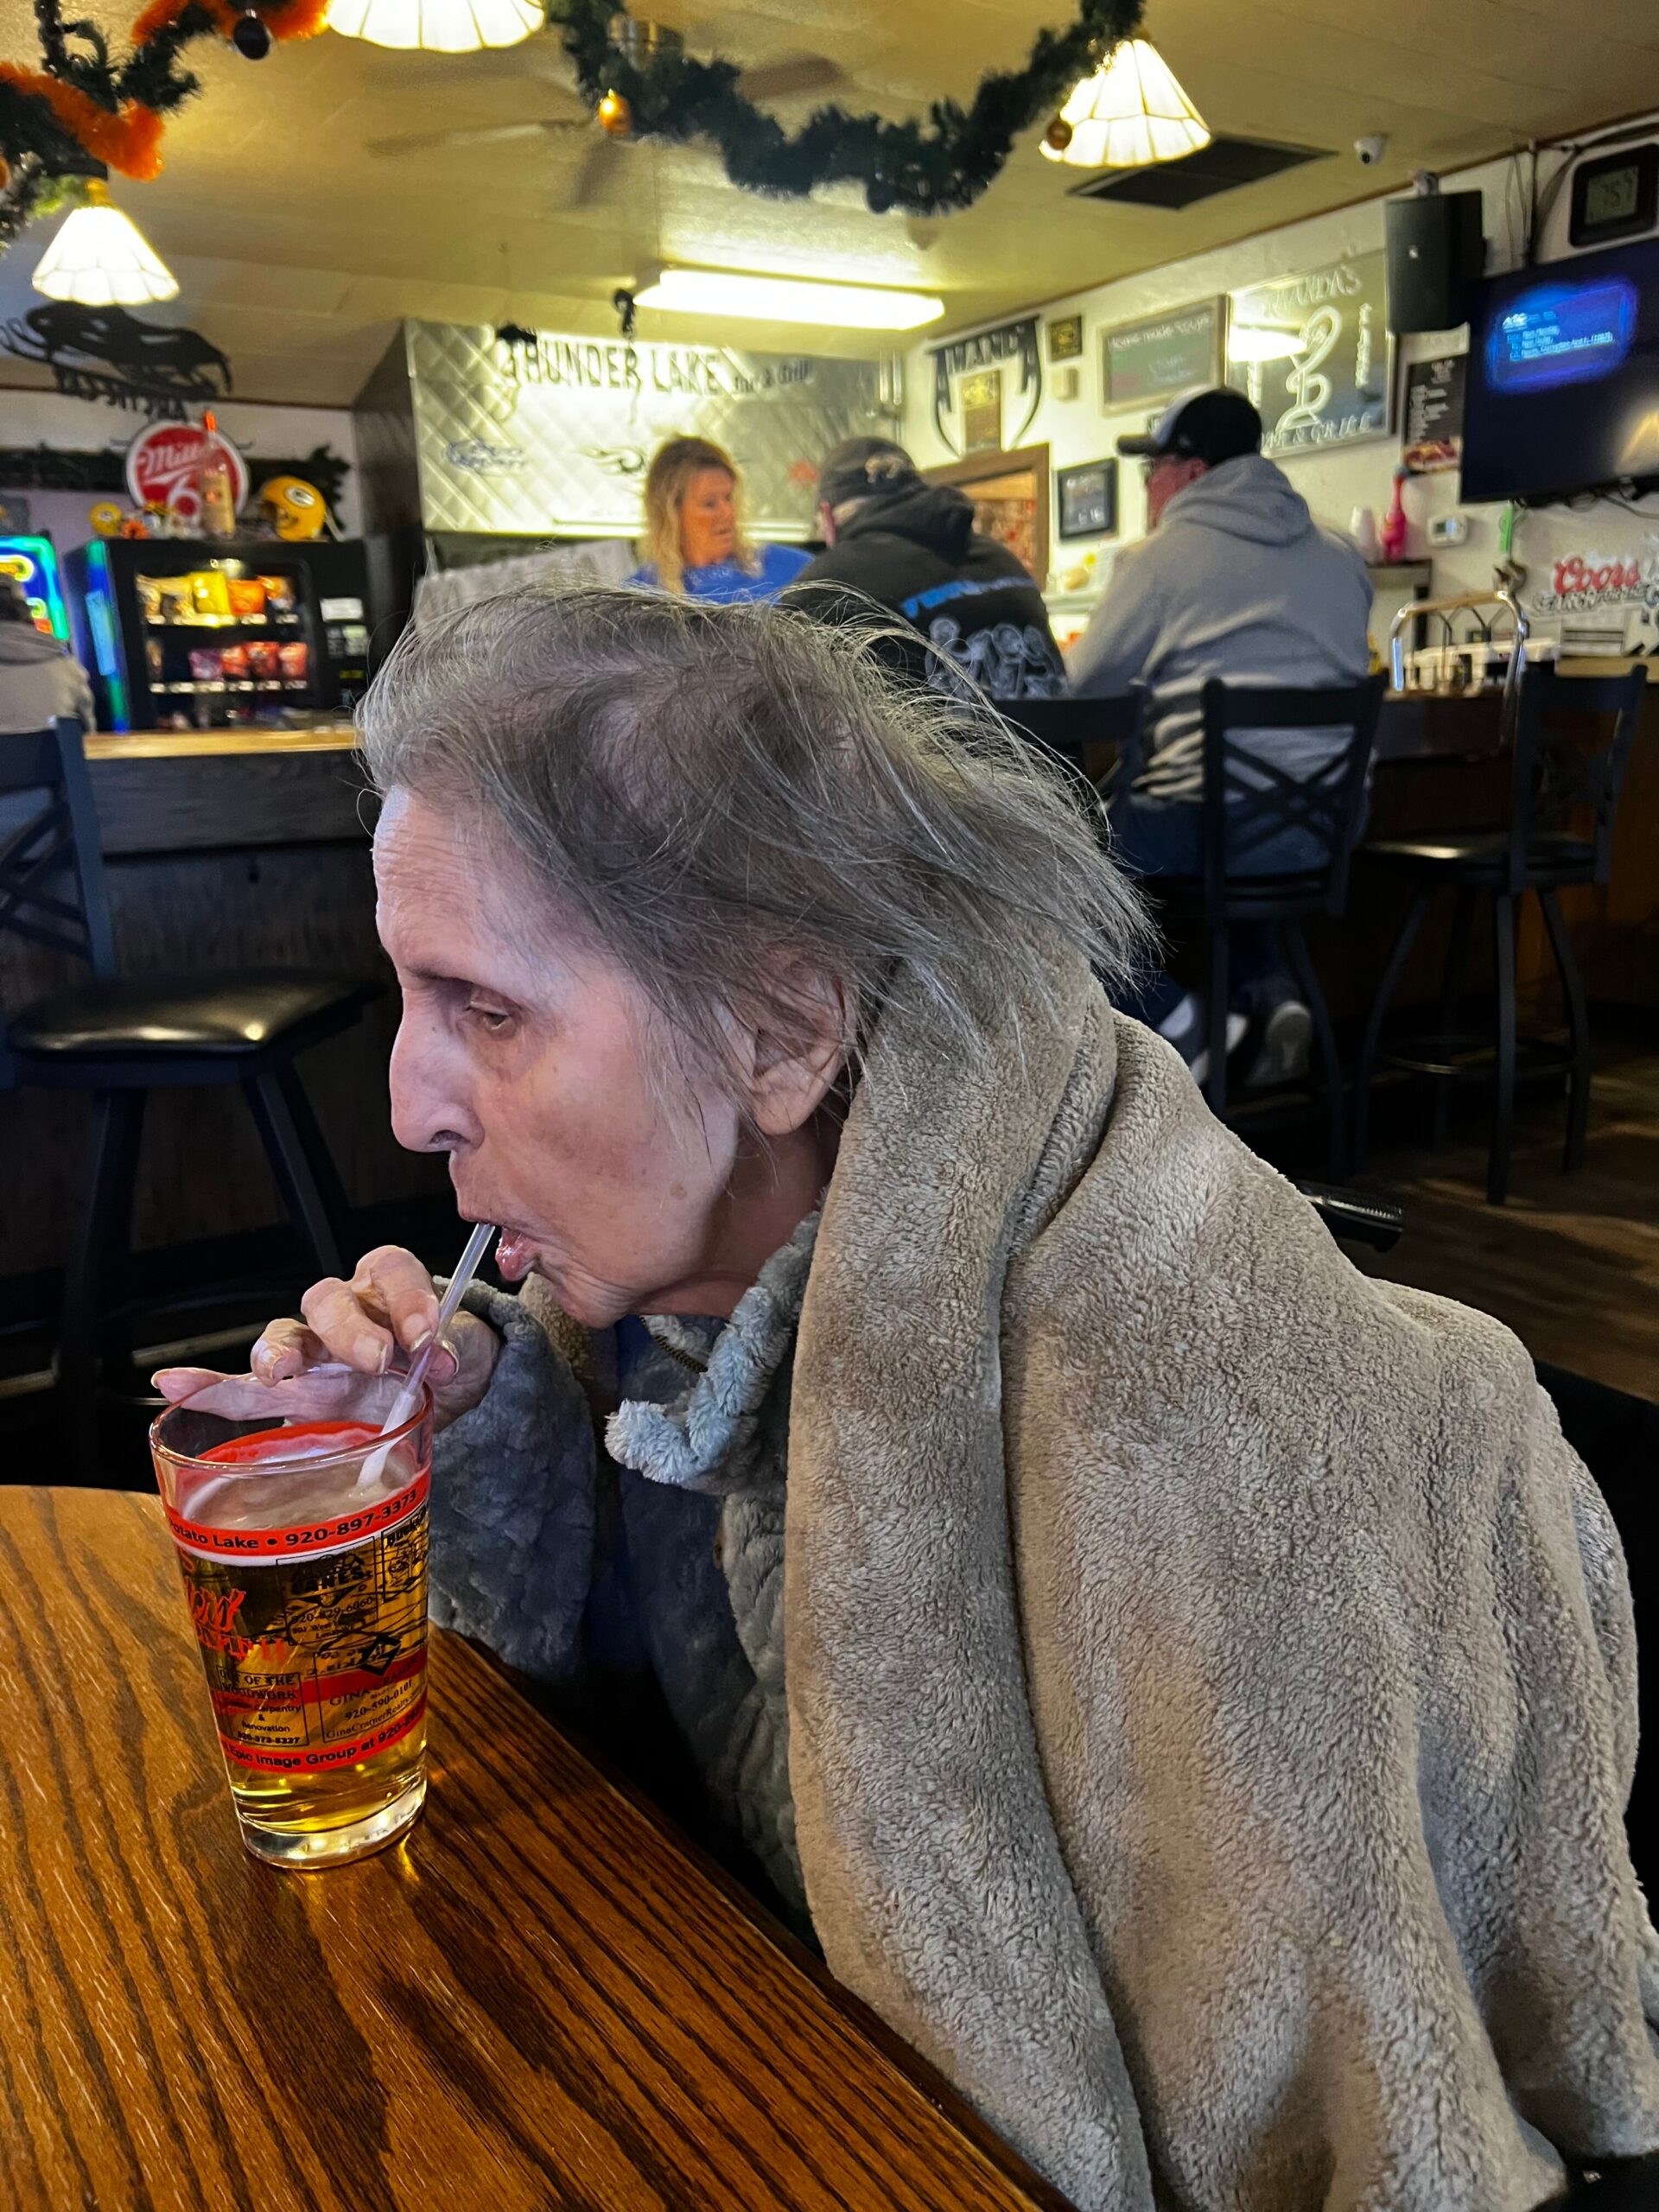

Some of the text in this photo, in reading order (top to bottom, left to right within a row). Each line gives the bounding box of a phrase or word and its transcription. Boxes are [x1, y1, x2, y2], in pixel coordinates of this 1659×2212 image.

[1554, 557, 1640, 595] Coors
[213, 1535, 259, 1549] Lake
[284, 1489, 417, 1547] 920-897-3373
[244, 1676, 262, 1686] OF
[329, 1688, 371, 1707] GINA
[256, 1753, 301, 1768] Image
[306, 1747, 357, 1765] Group
[360, 1739, 375, 1752] at
